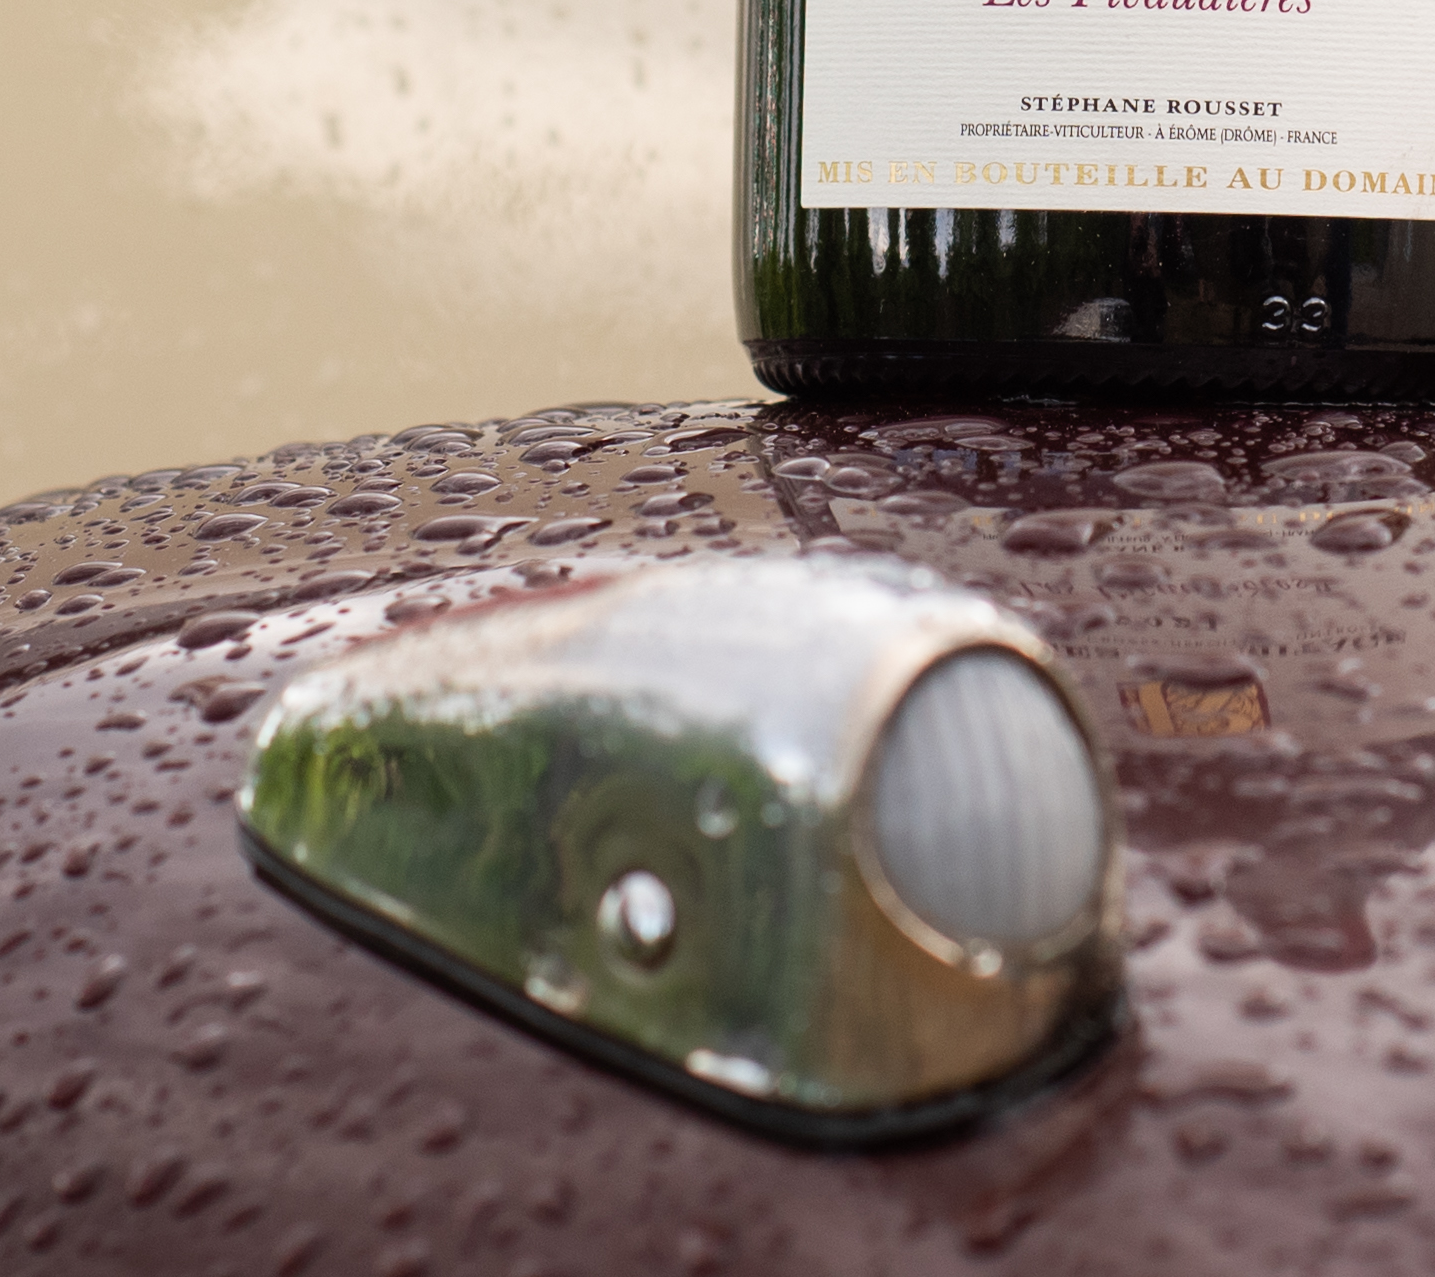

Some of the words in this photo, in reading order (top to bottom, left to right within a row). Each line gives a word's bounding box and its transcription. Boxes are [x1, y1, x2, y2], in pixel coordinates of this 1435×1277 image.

[1020, 93, 1157, 115] STÉPHANE
[1166, 99, 1284, 118] ROUSSET
[960, 120, 1146, 141] PROPRIÉTAIRE-VITICULTEUR
[1168, 124, 1219, 143] ÉRÔME
[1220, 125, 1278, 146] (DRÔME)
[1287, 129, 1340, 146] FRANCE
[817, 160, 874, 187] MIS
[887, 161, 937, 187] EN
[953, 161, 1209, 190] BOUTEILLE
[1226, 166, 1285, 192] AU
